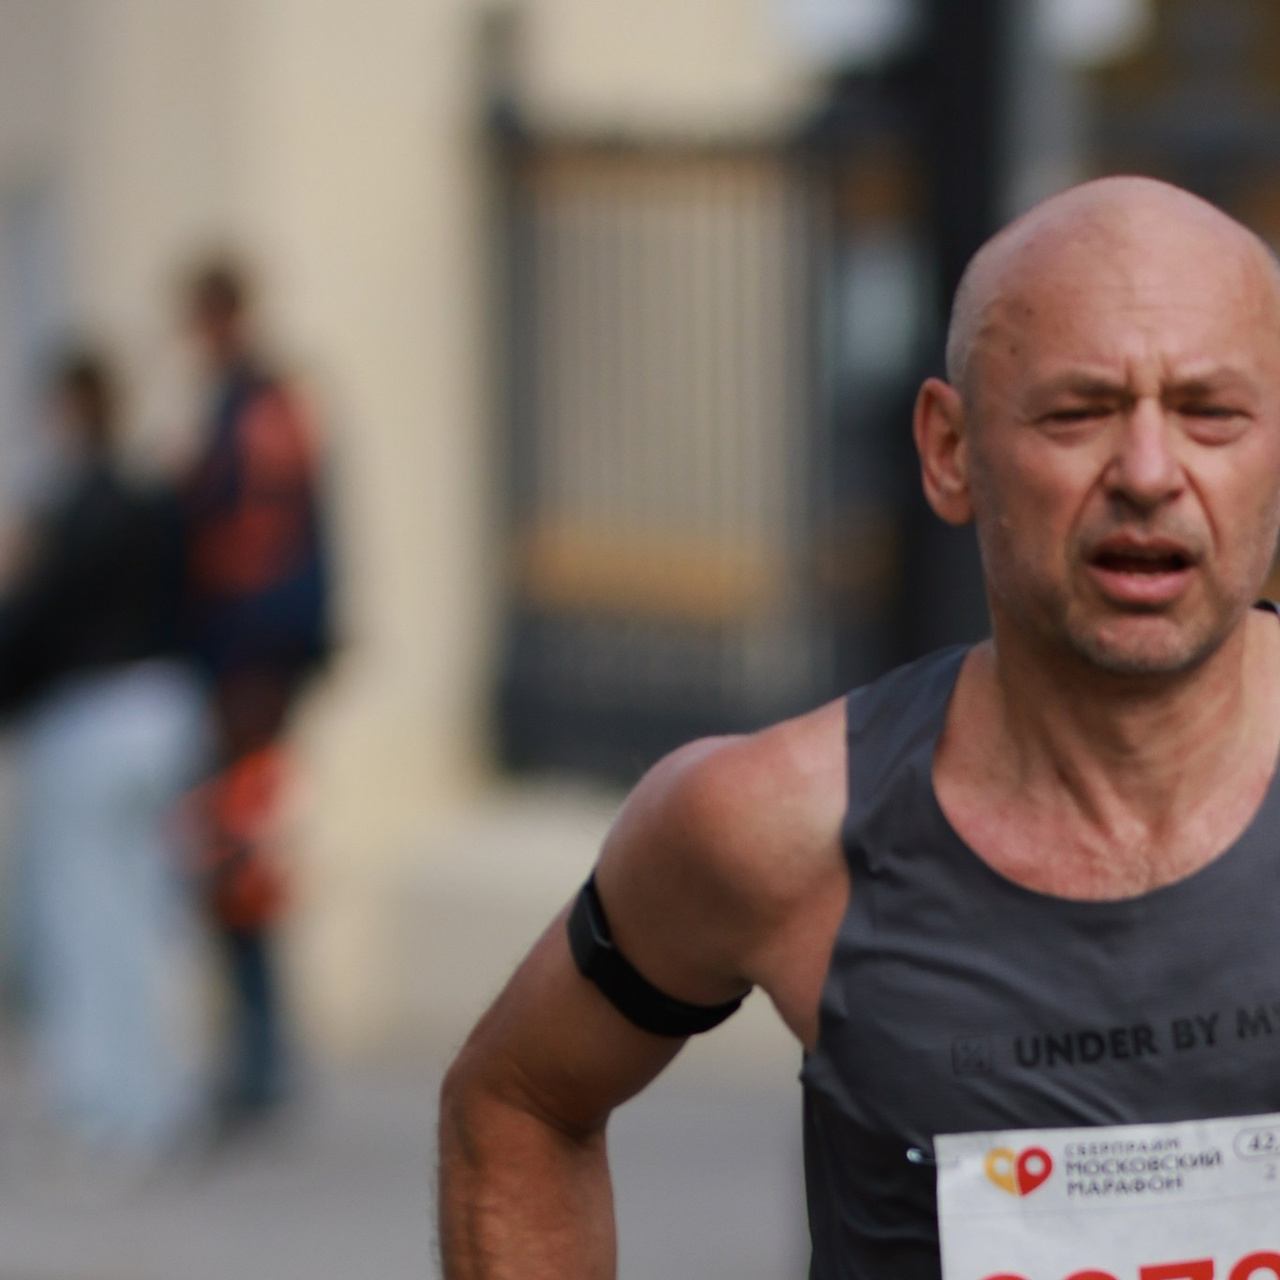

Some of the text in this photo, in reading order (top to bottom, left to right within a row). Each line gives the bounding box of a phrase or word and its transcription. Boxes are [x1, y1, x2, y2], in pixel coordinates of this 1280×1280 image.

[1013, 1024, 1159, 1069] UNDER
[1171, 1011, 1220, 1050] BY
[1065, 1148, 1222, 1176] МОСКОВСКИЙ
[1067, 1174, 1183, 1196] МАРАФОН
